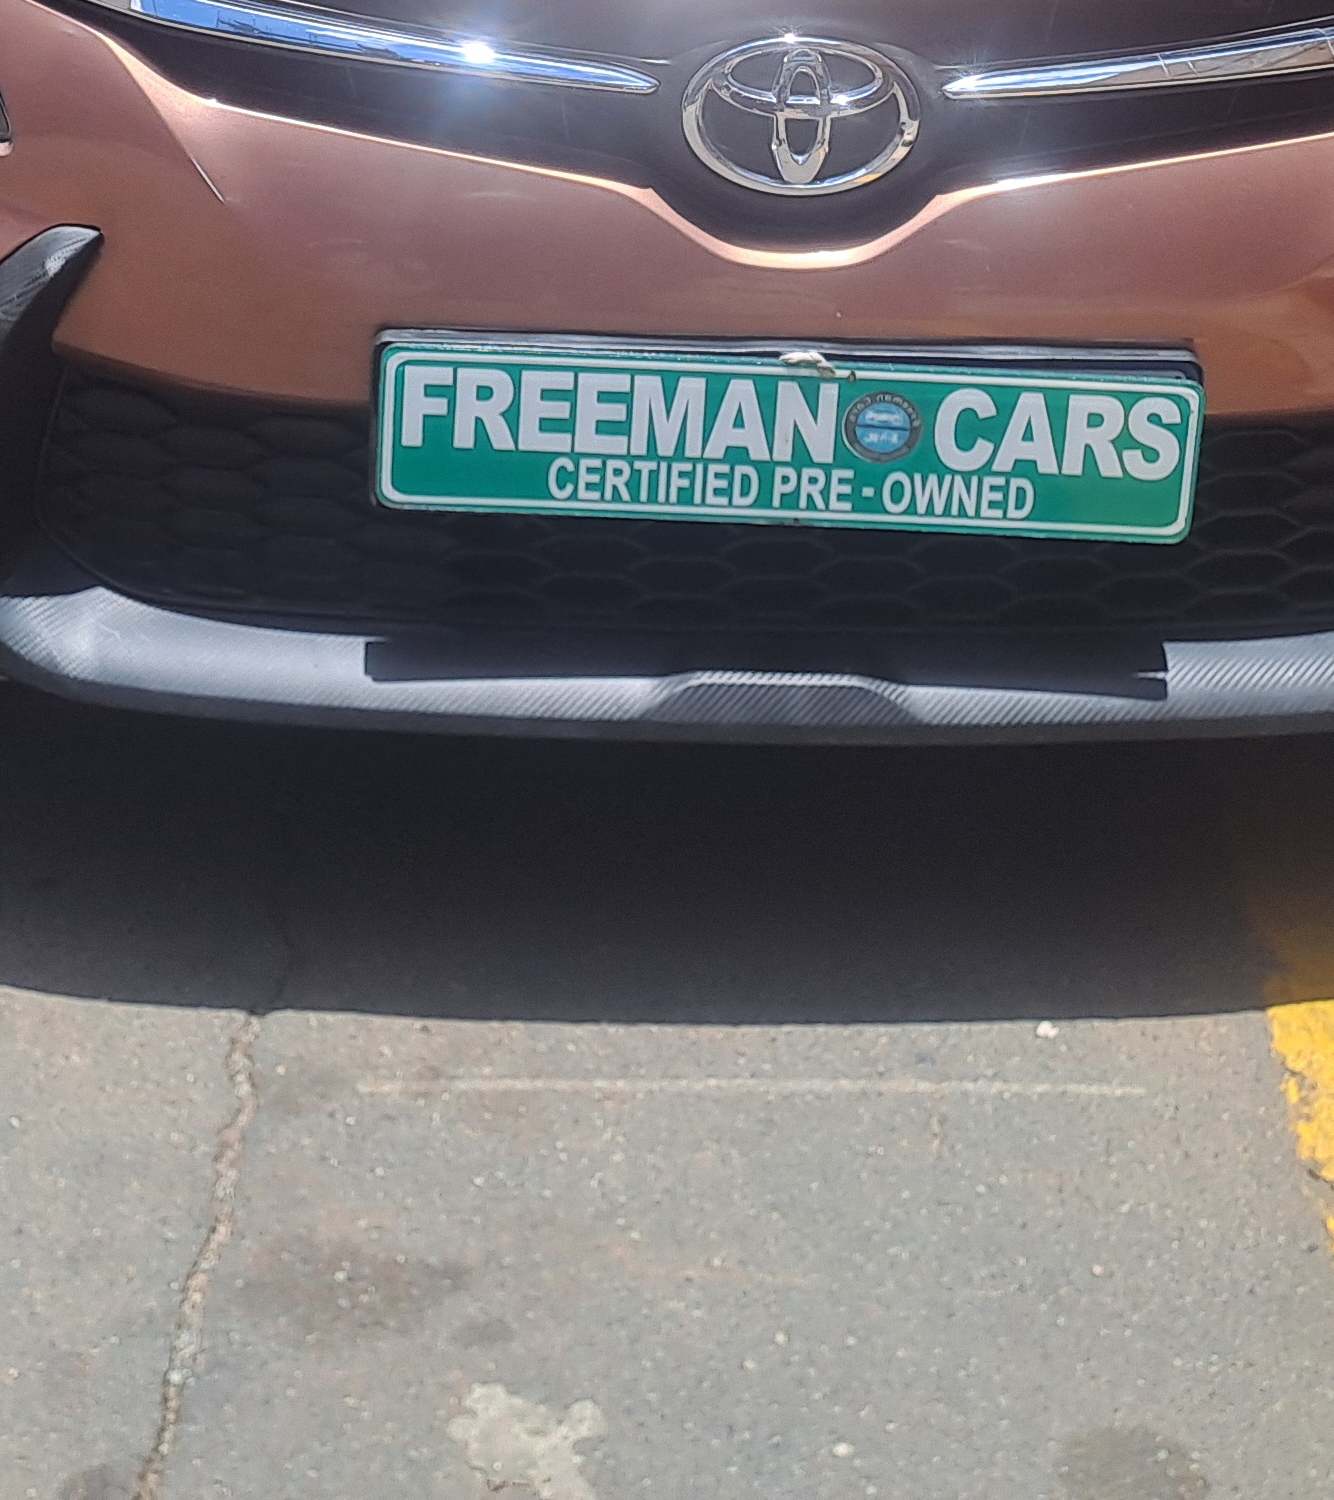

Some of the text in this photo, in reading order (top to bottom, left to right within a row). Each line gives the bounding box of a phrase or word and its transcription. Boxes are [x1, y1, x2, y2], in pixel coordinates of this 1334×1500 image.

[400, 364, 1182, 482] FREEMAN CARS
[547, 456, 759, 507] CERTIFIED
